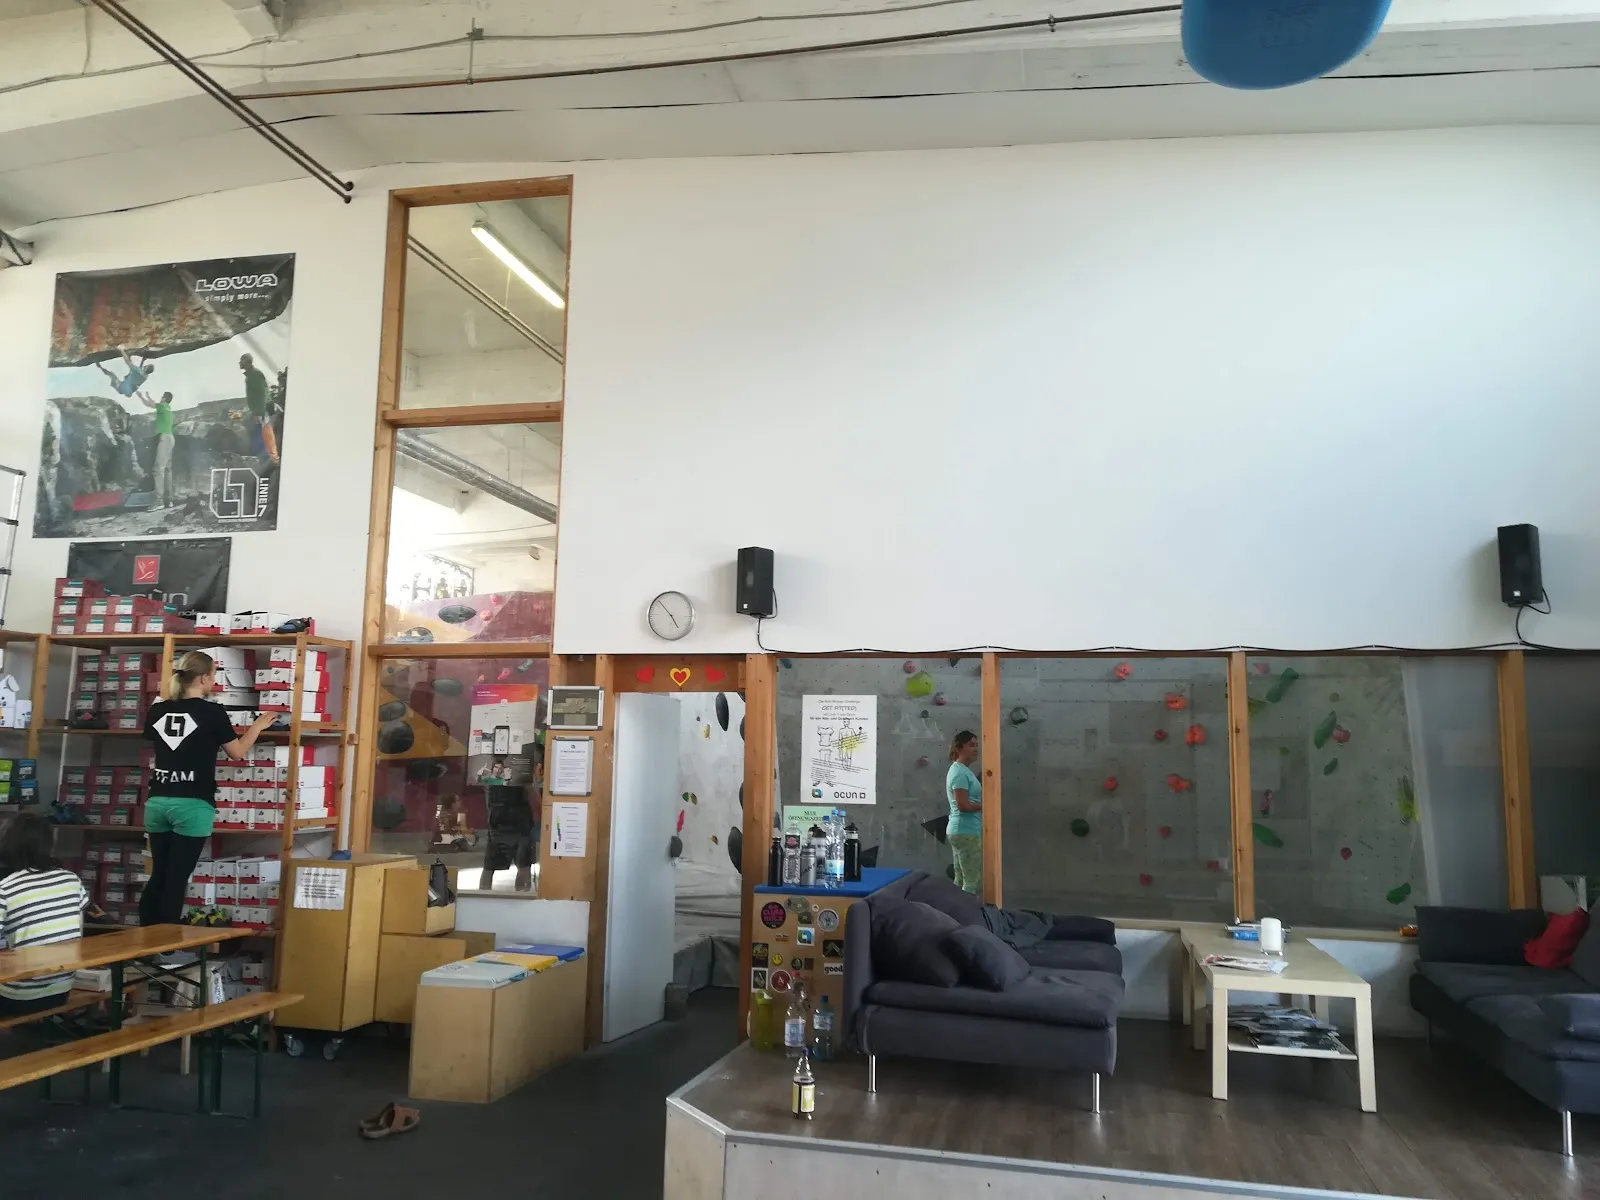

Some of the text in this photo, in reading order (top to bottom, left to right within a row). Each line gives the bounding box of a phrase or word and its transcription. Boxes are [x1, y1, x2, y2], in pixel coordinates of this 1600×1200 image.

[195, 273, 278, 292] LOWA
[205, 293, 235, 302] simply
[834, 791, 858, 799] ocun
[824, 965, 843, 974] good
